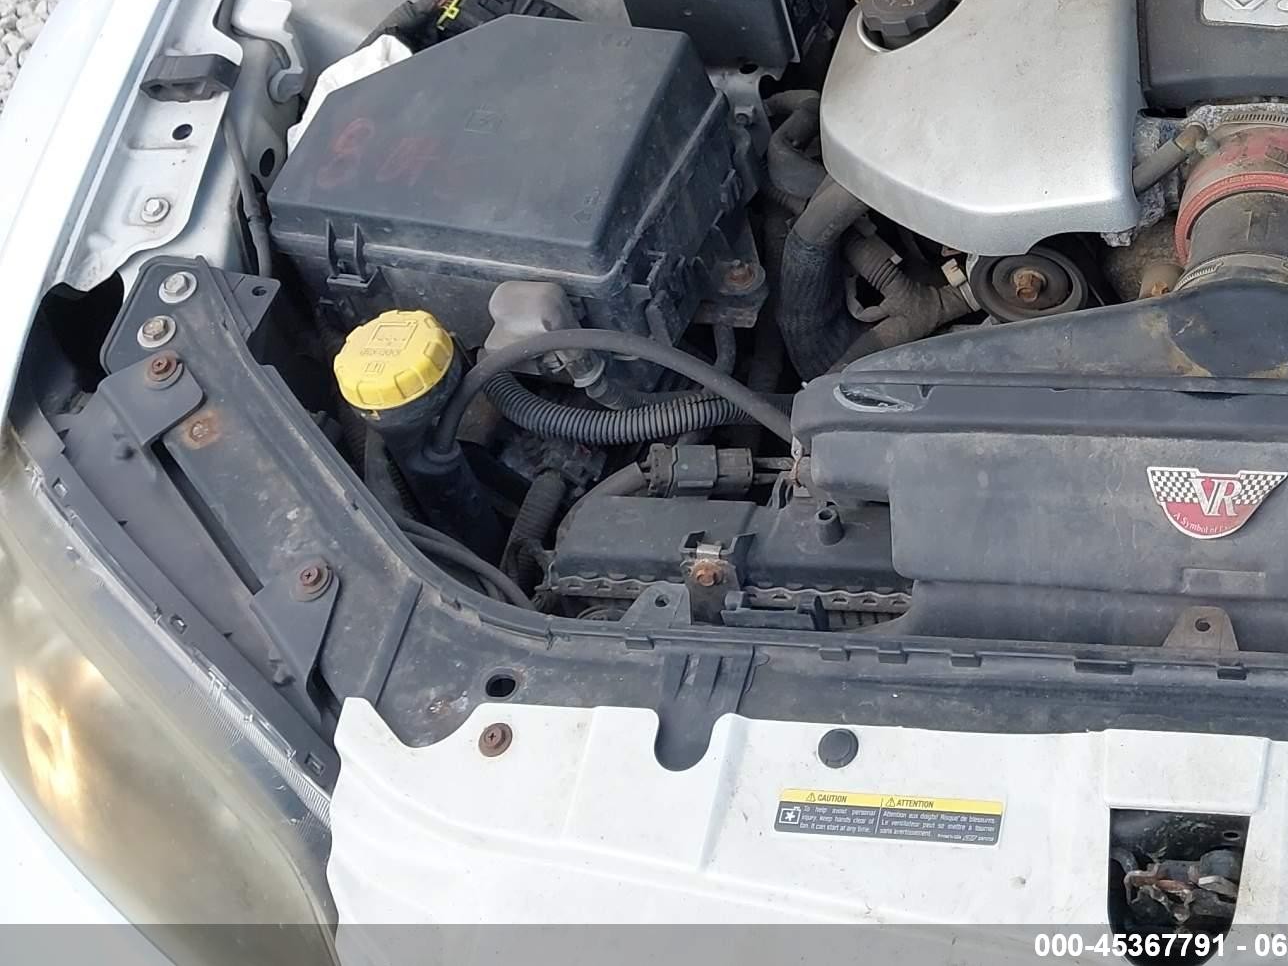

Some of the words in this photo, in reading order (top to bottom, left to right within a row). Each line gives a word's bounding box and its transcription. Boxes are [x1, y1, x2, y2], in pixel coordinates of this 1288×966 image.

[1188, 478, 1242, 516] VR
[1180, 516, 1208, 533] Symbol
[817, 794, 847, 802] CAUTION
[896, 799, 933, 808] ATTENTION
[815, 806, 827, 814] help
[851, 808, 875, 816] personal
